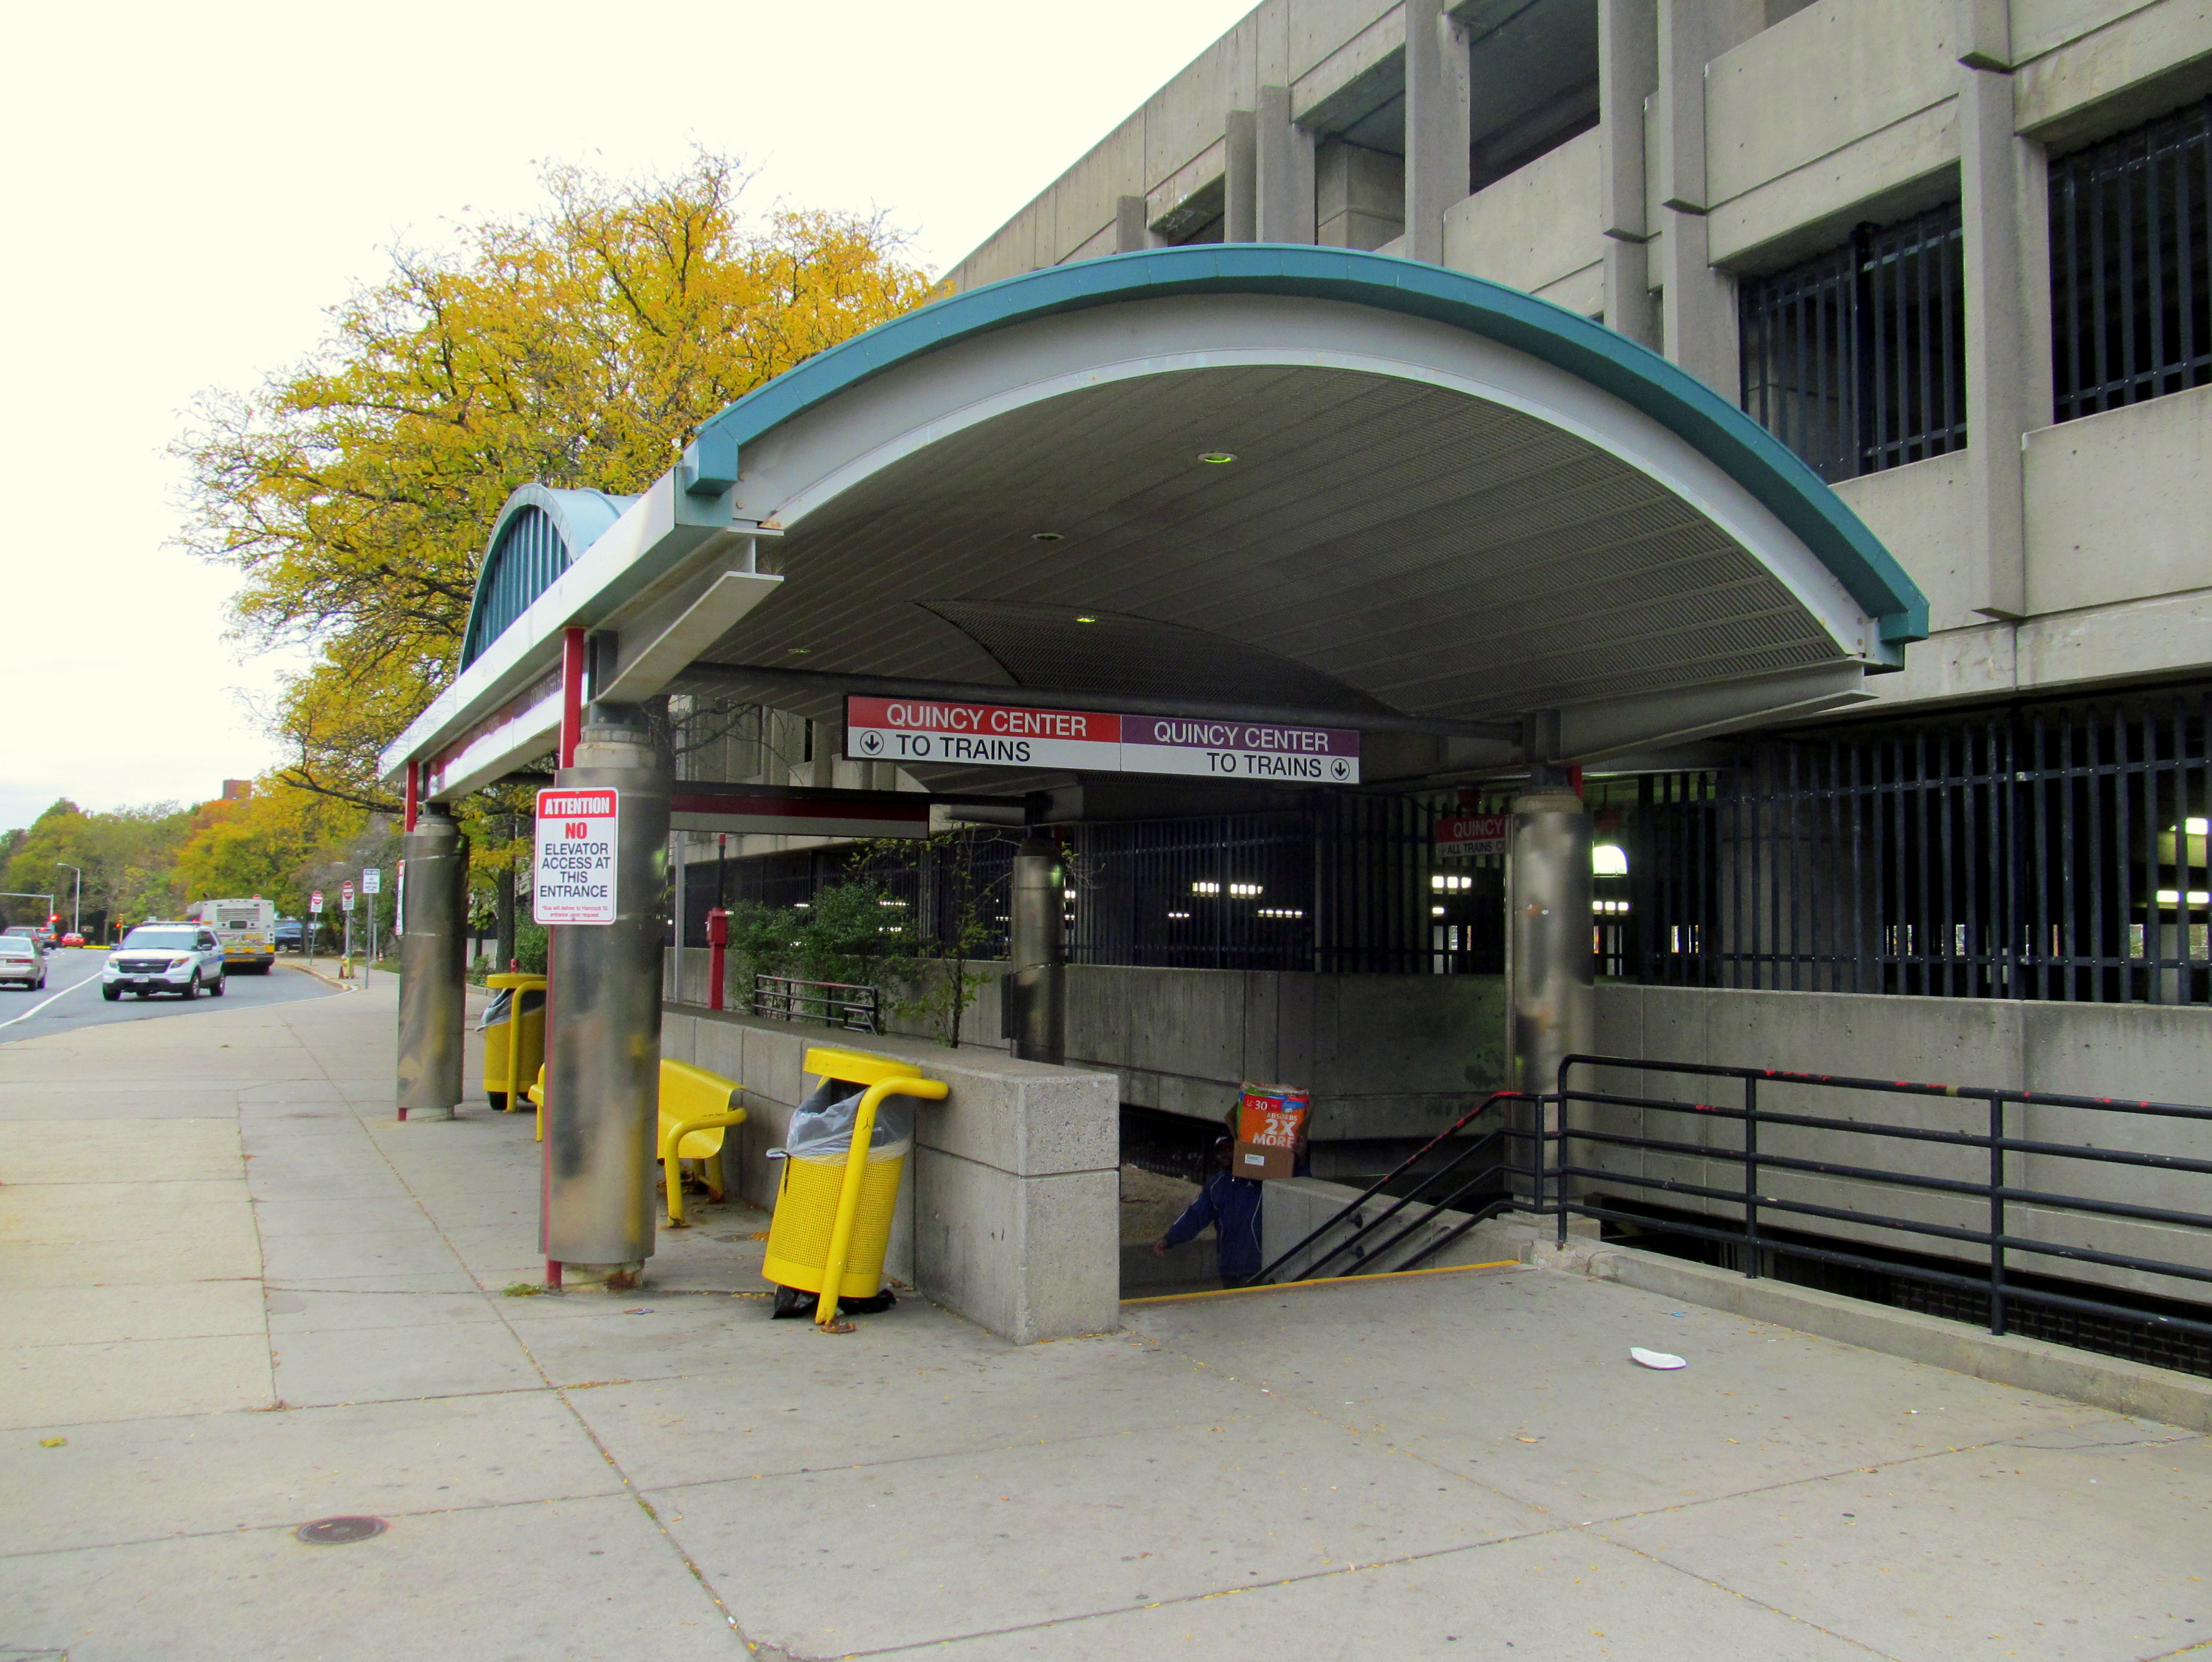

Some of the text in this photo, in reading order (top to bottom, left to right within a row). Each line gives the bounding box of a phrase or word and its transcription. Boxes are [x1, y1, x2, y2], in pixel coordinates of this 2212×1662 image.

[887, 704, 1087, 737] QUINCY CENTER
[1154, 721, 1329, 752] QUINCY CENTER
[896, 734, 1031, 762] TO TRAINS
[1207, 752, 1322, 778] TO TRAINS
[544, 797, 610, 815] ATTENTION
[564, 822, 587, 839] NO
[1453, 819, 1503, 838] QUINCY
[545, 843, 608, 855] ELEVATOR
[1447, 844, 1461, 854] ALL
[1463, 842, 1492, 853] TRAINS
[542, 857, 611, 869] ACCESS AT
[560, 871, 588, 883] THIS
[540, 885, 608, 897] ENTRANCE
[1255, 1100, 1268, 1111] 30
[1267, 1113, 1298, 1121] ABSORBS
[1264, 1118, 1297, 1137] 2X
[1252, 1132, 1295, 1148] MORE
